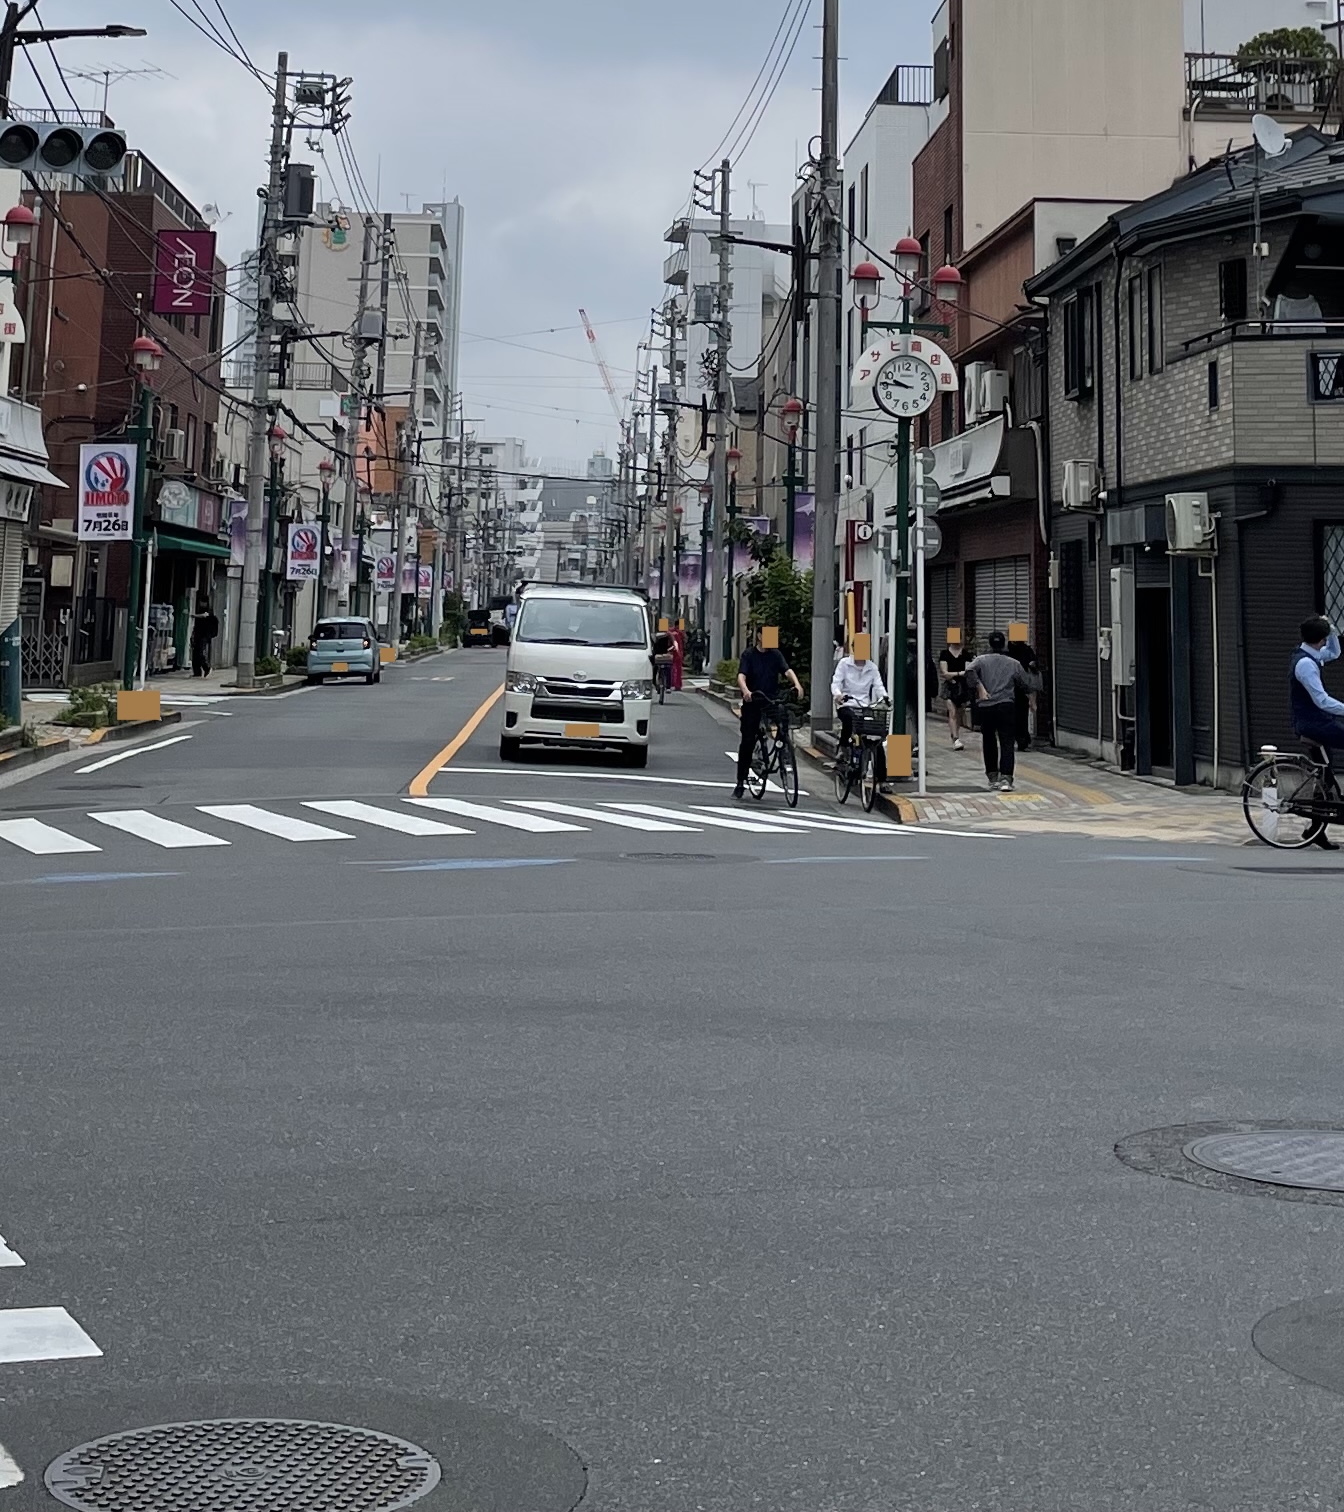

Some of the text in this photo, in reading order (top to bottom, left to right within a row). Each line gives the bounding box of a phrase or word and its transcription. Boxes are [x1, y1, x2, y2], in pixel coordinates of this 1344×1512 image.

[860, 341, 952, 385] アサヒ商店街
[83, 519, 129, 532] 7月26日
